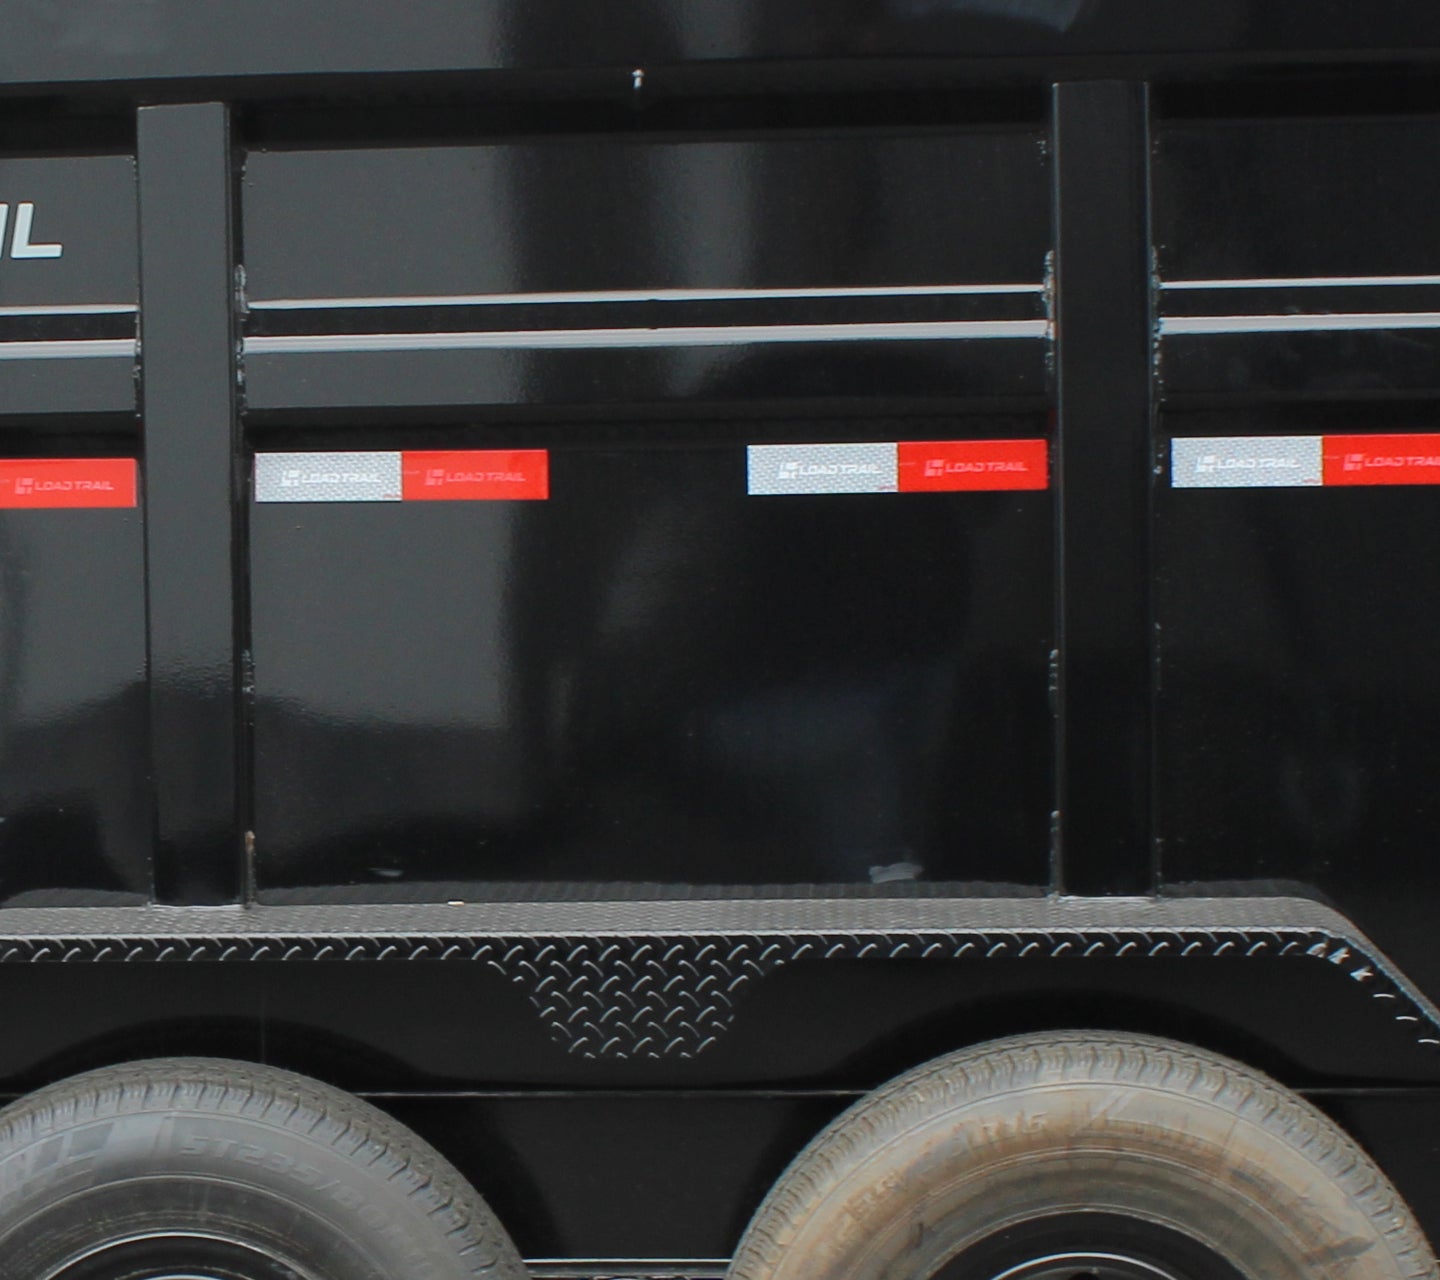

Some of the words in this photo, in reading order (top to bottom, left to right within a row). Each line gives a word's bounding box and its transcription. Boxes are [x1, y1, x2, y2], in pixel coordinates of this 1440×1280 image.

[946, 463, 985, 472] LOAD
[985, 461, 1028, 471] TRAIL
[1366, 457, 1404, 466] LOAD
[446, 472, 484, 482] LOAD
[484, 472, 526, 482] TRAIL
[34, 481, 72, 491] LOAD
[73, 480, 114, 490] TRAIL
